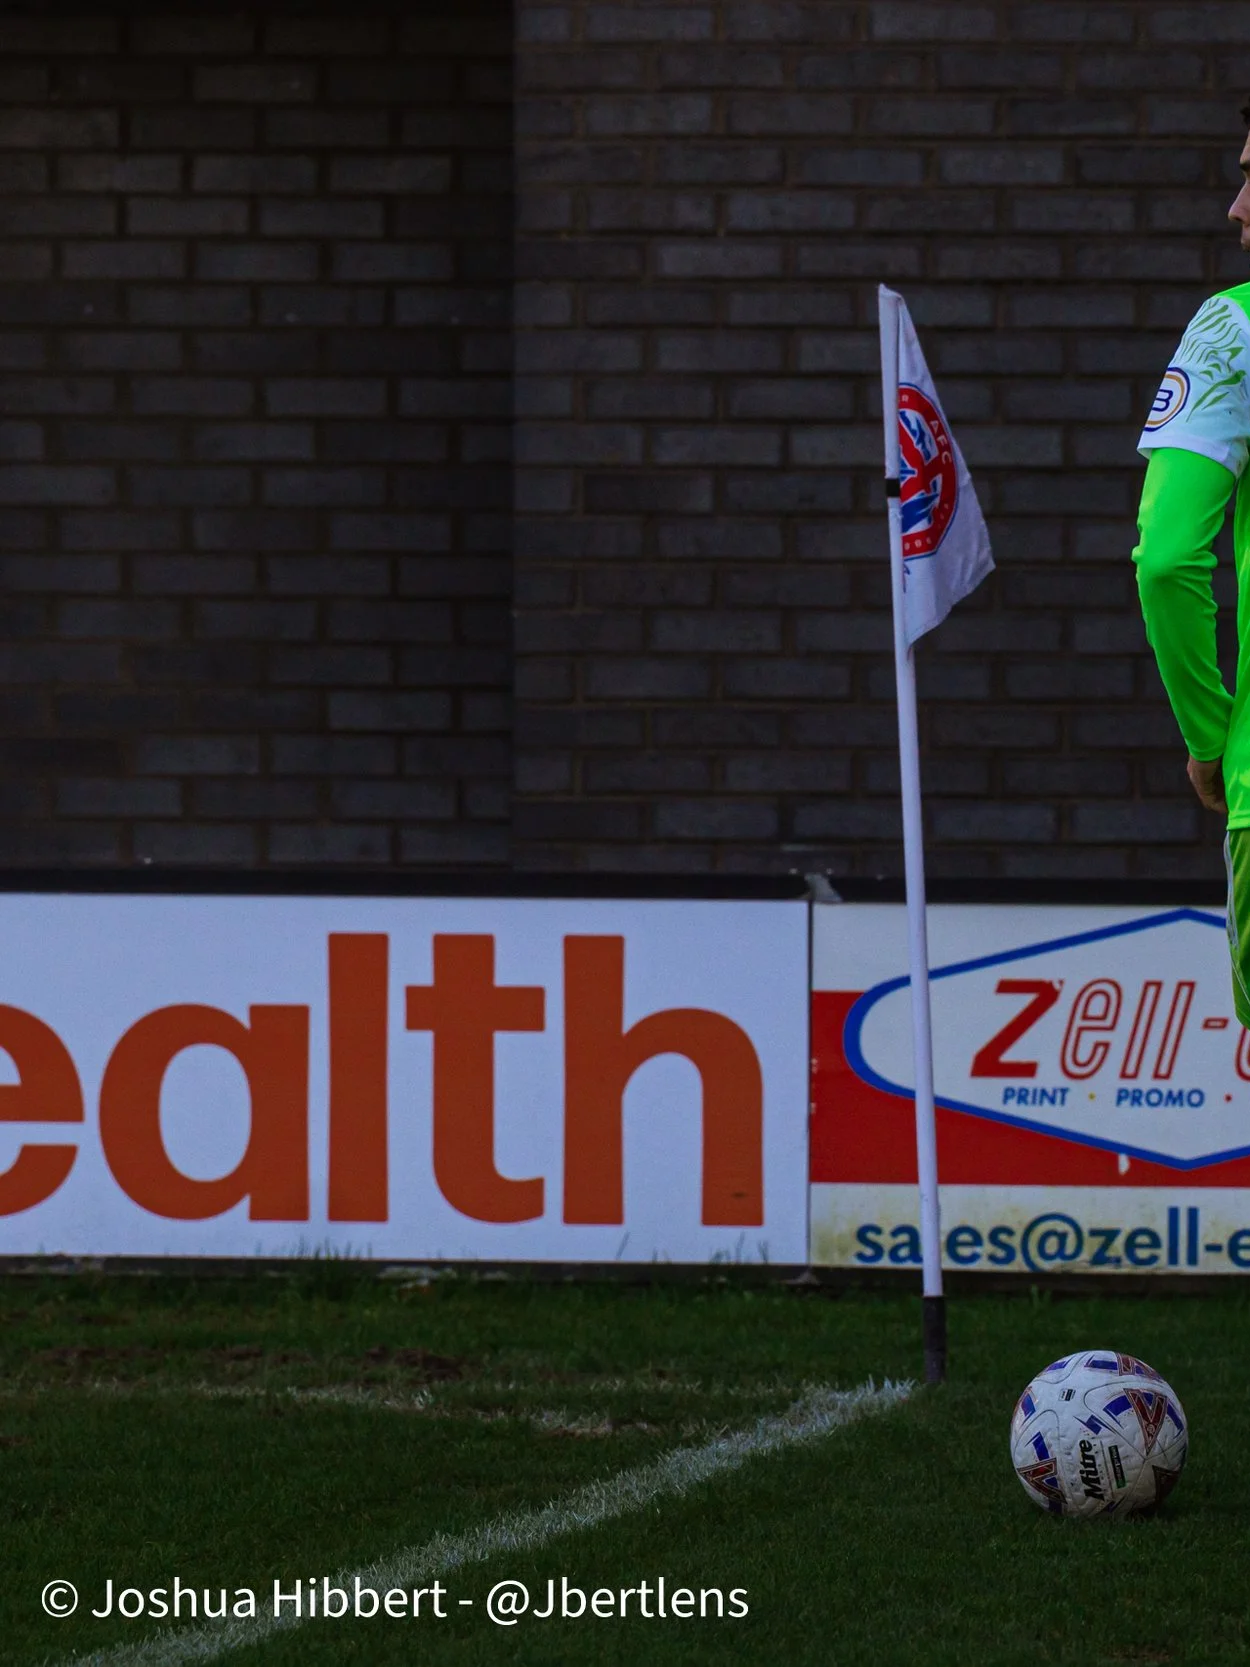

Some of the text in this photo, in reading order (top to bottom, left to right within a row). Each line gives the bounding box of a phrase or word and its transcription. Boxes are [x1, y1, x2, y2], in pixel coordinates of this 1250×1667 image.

[1003, 1087, 1205, 1109] PRINT PROMO
[1078, 1439, 1105, 1501] Mitre
